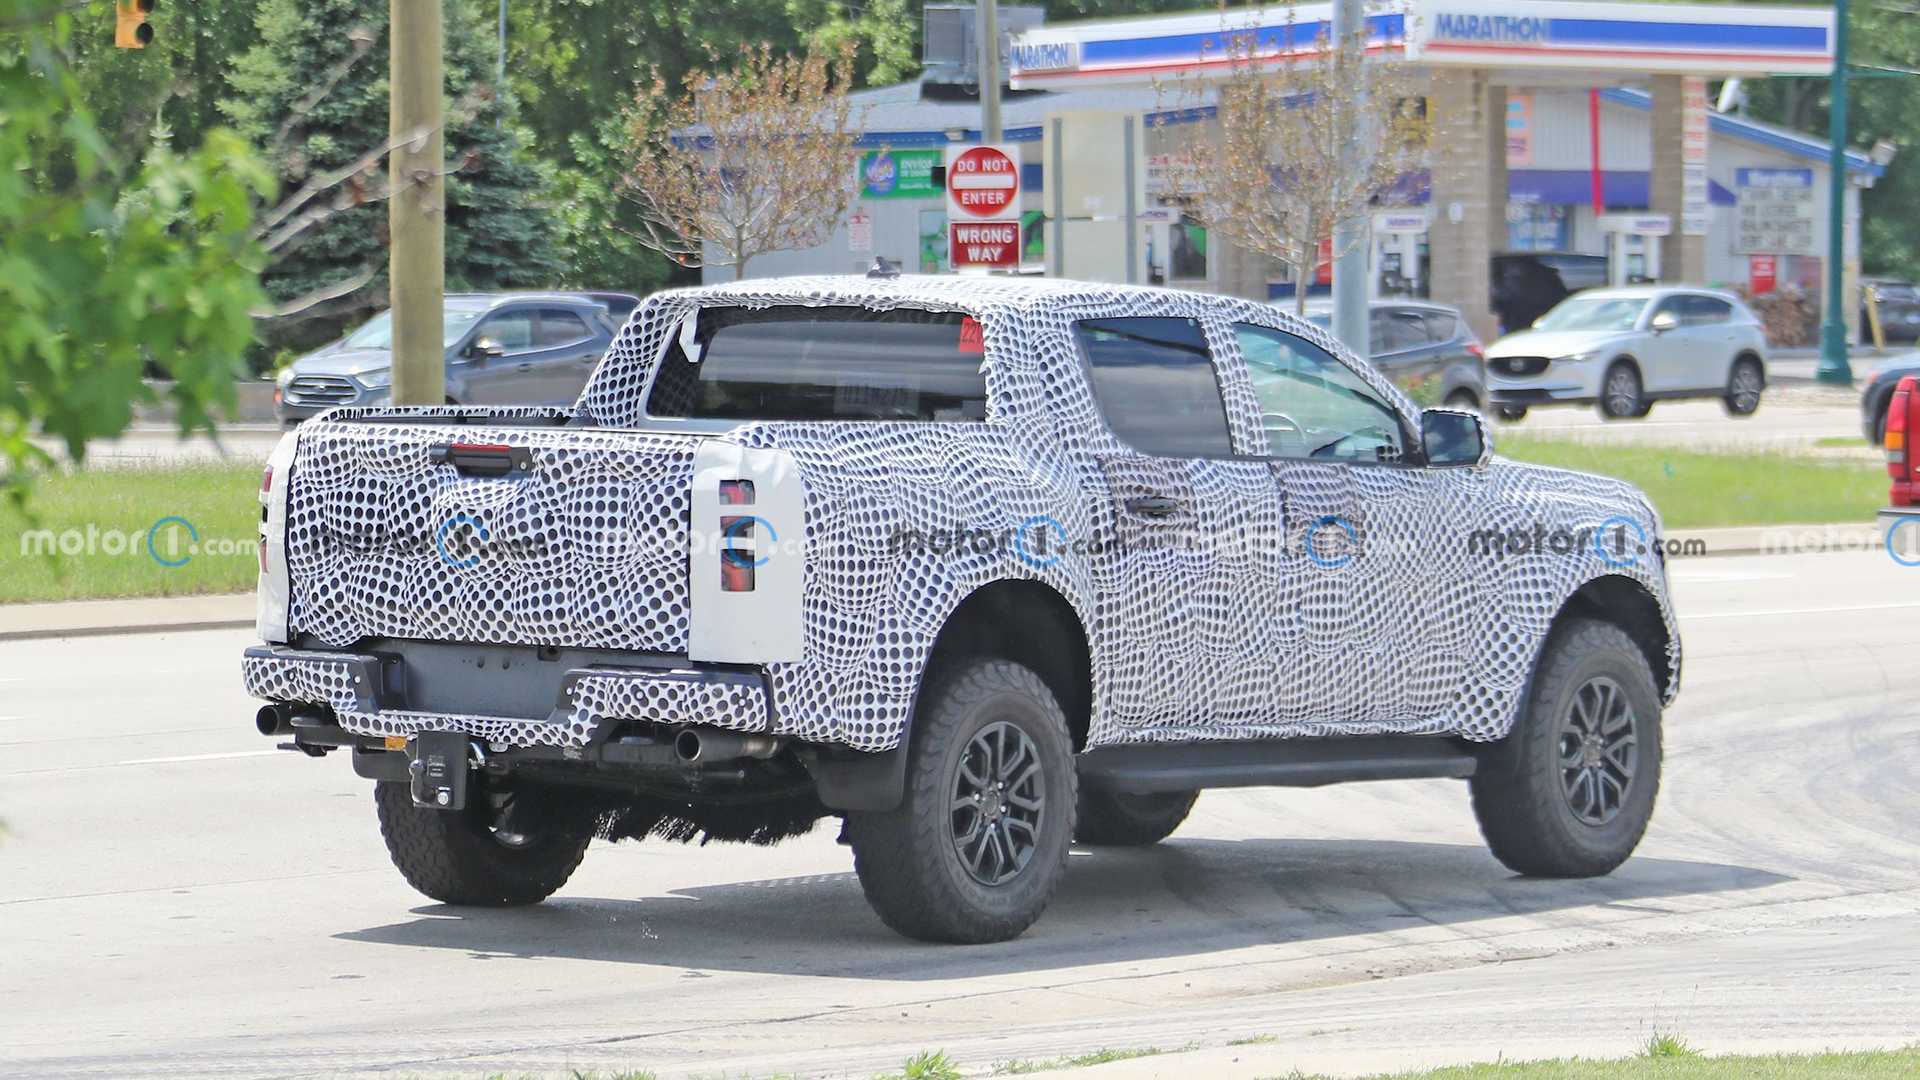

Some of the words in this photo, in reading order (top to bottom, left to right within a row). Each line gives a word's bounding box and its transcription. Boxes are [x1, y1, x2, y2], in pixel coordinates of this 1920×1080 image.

[1435, 14, 1546, 42] MARATHON
[1011, 43, 1067, 69] MARATHON
[957, 160, 976, 172] DO
[982, 160, 1009, 172] NOT
[961, 191, 1005, 205] ENTER
[957, 229, 1013, 244] WRONG
[967, 246, 1003, 262] WAY
